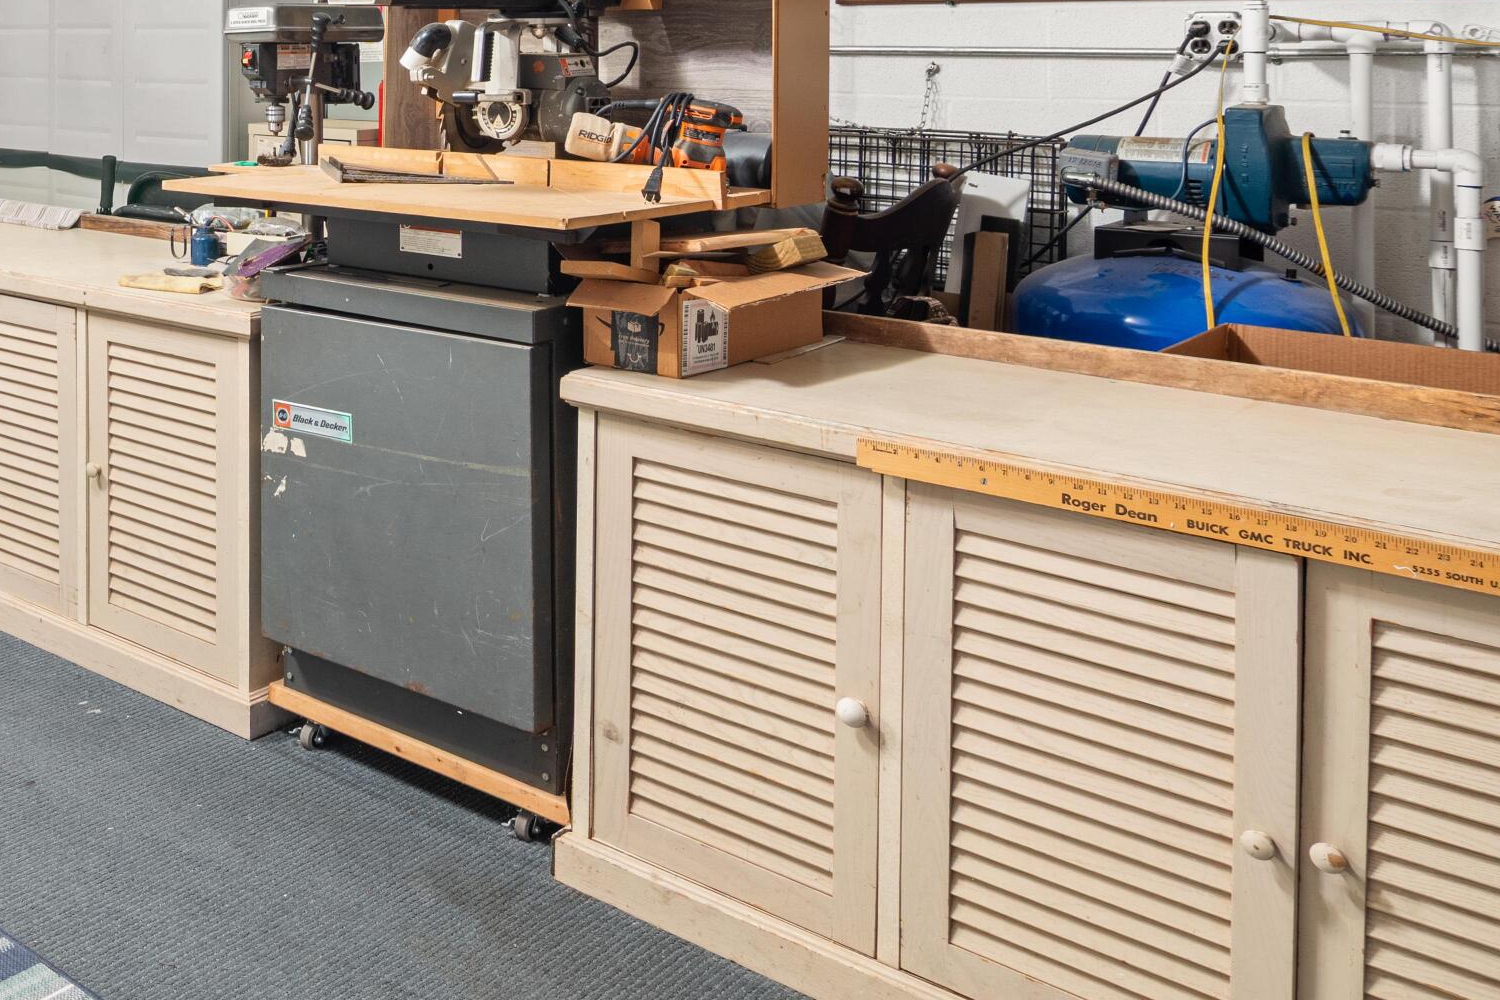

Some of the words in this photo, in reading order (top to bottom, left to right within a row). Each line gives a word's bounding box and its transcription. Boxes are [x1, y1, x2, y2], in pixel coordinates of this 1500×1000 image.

[578, 129, 613, 144] RIDGID
[292, 413, 312, 426] Black
[1061, 492, 1106, 512] Roger
[1115, 503, 1158, 523] Dean
[1186, 518, 1229, 536] BUICK
[1238, 529, 1274, 544] GMC
[1283, 537, 1333, 557] TRUCK
[1343, 549, 1374, 565] INC.
[1412, 565, 1440, 577] 5255
[1445, 571, 1483, 586] SOUTH
